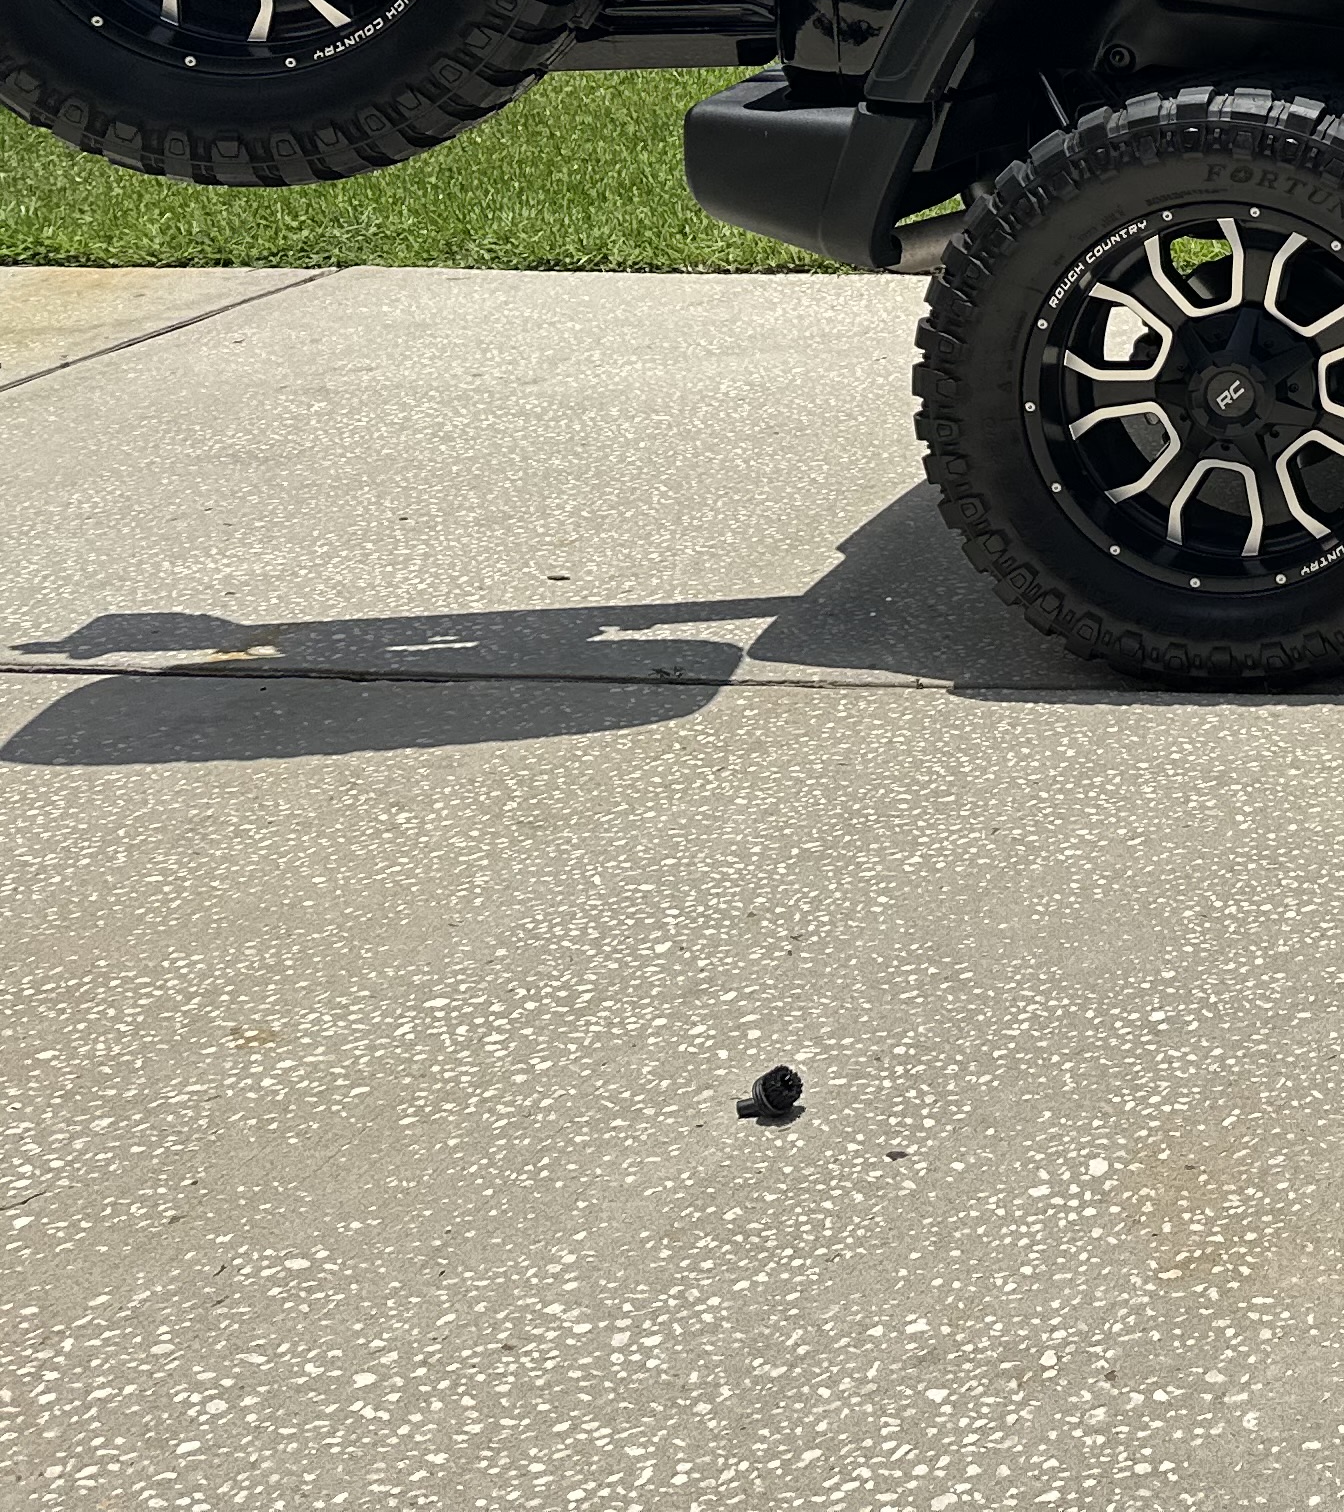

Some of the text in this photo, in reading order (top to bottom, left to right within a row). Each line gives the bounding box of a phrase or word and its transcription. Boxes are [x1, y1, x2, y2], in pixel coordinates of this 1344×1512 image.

[313, 17, 384, 60] COUNTRY
[1048, 262, 1085, 308] ROUGH
[1085, 220, 1147, 264] COUNTRY
[1216, 379, 1245, 410] RC
